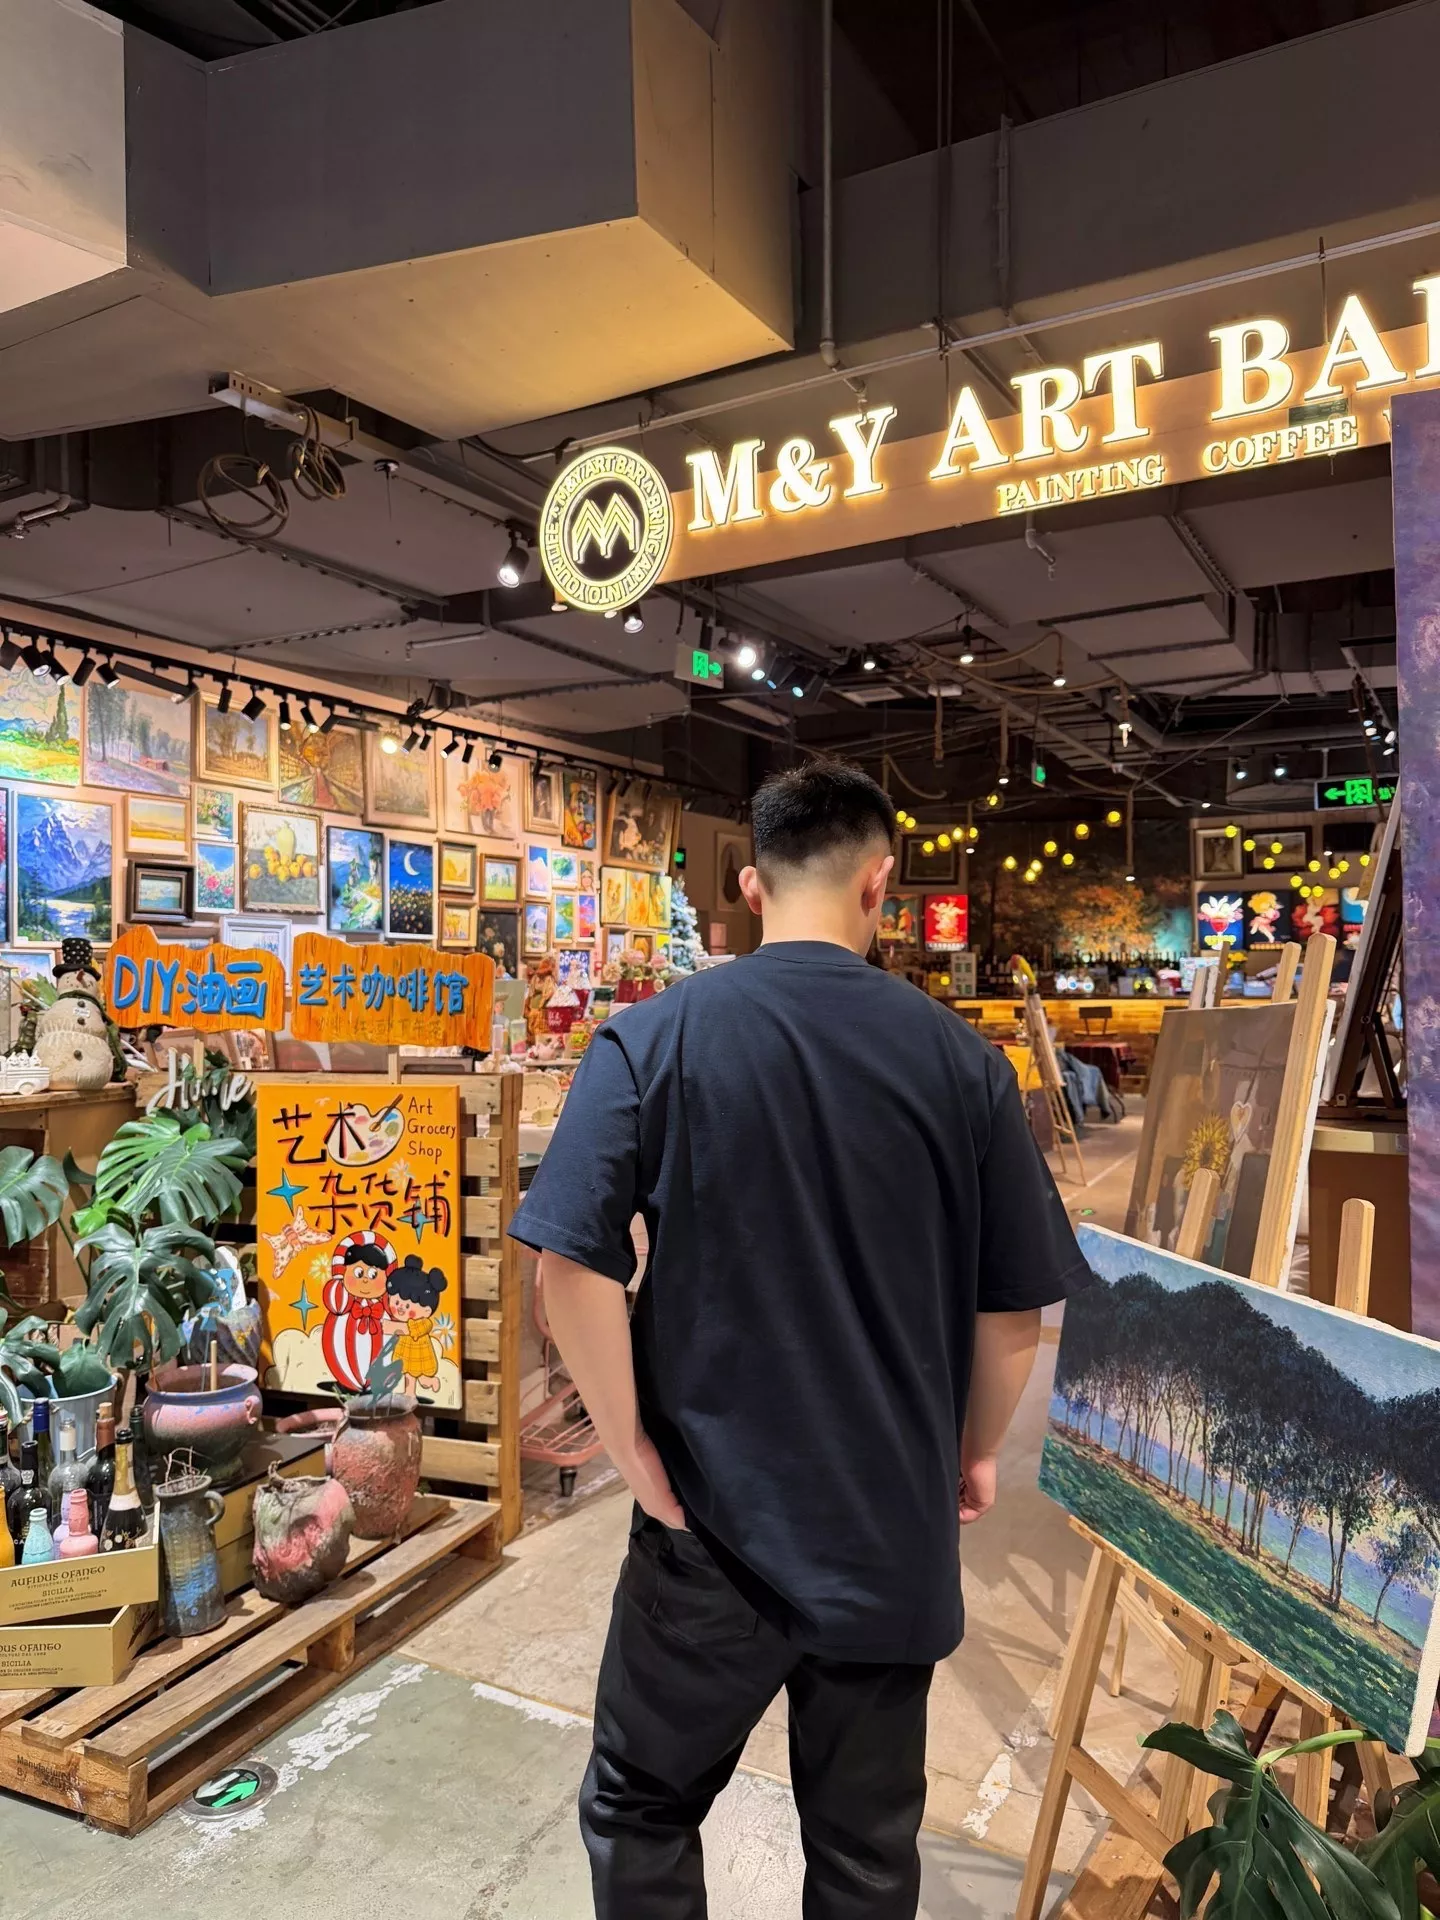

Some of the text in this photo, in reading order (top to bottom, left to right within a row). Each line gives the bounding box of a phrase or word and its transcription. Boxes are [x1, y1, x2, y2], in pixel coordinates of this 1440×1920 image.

[686, 405, 898, 533] M&Y
[928, 340, 1165, 481] ART
[584, 455, 614, 477] ART
[613, 454, 648, 488] BAR
[996, 453, 1166, 515] PAINTING
[1202, 415, 1359, 474] COFFEE
[298, 962, 470, 1016] 艺术咖啡馆
[408, 1096, 433, 1116] Art
[272, 1101, 366, 1166] 艺术
[407, 1118, 457, 1140] Grocery
[407, 1140, 443, 1165] Shop
[307, 1169, 452, 1238] 杂货铺
[10, 1572, 59, 1588] AUFIDUS
[42, 1586, 75, 1598] SICILIA
